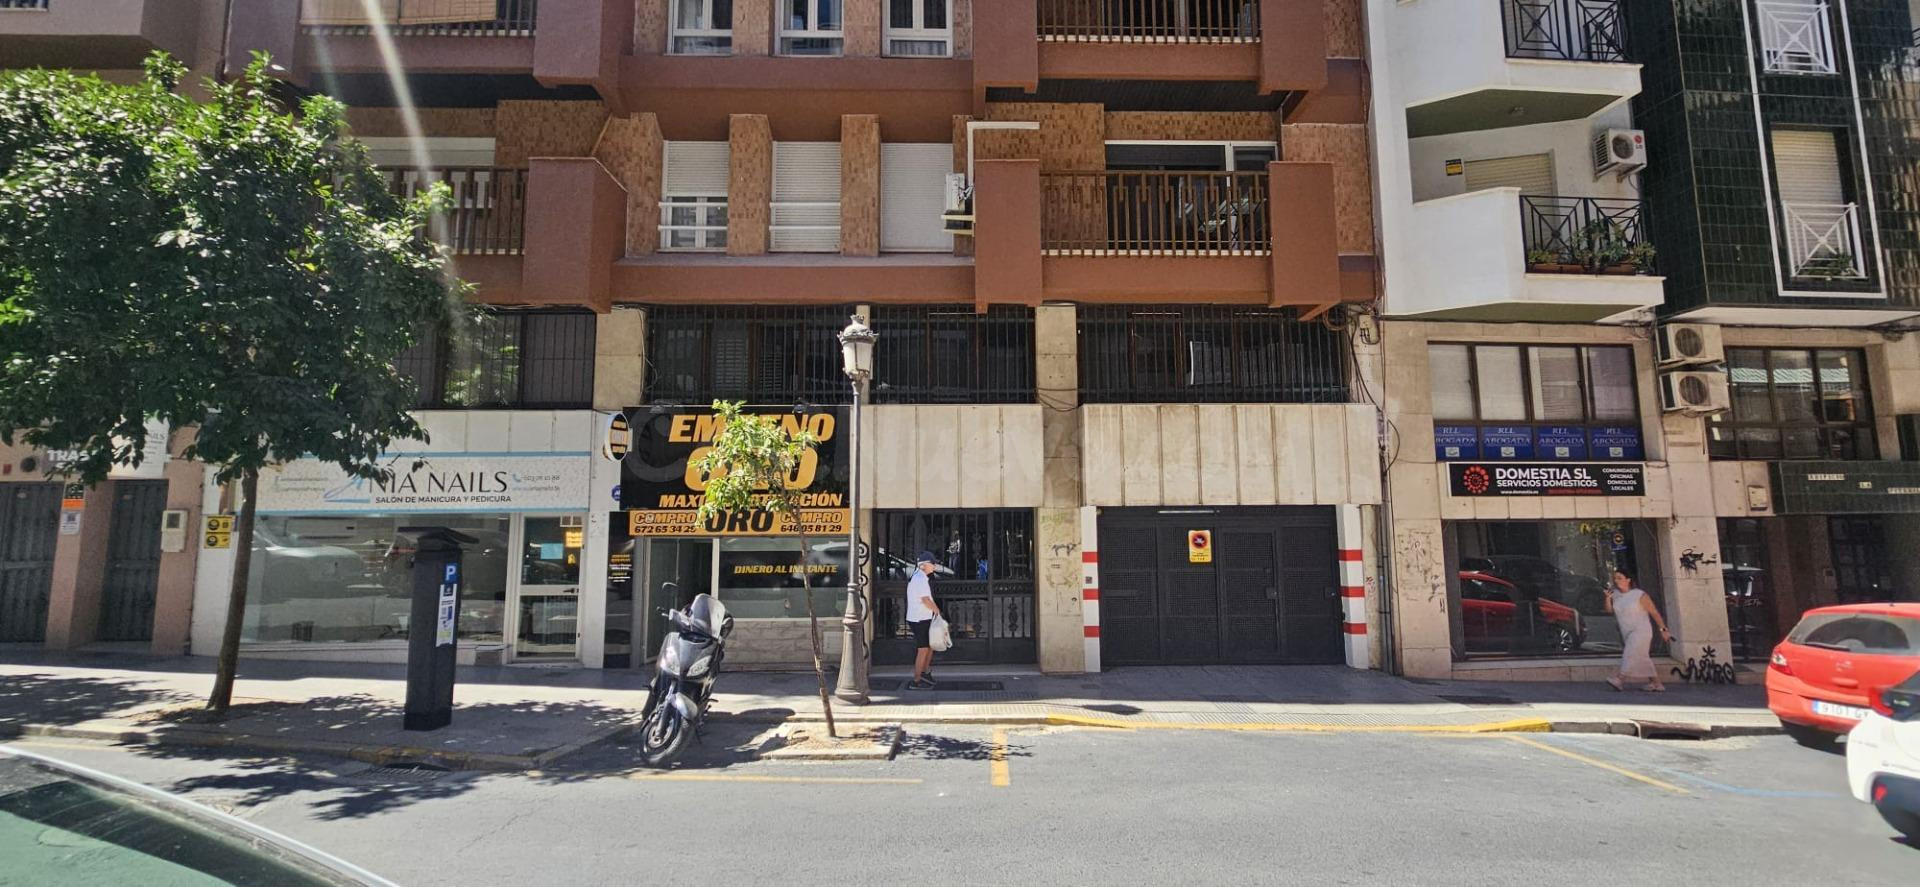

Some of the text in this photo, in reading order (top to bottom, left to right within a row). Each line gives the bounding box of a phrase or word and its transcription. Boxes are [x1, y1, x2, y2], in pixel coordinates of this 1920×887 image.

[1495, 468, 1592, 480] DOMESTIA SL
[428, 470, 508, 493] NAILS
[1496, 479, 1598, 488] SERVICIOS DOMESTICOS
[471, 495, 512, 503] PEDICURA
[635, 511, 697, 524] COMPRO
[705, 508, 774, 532] ORO
[635, 525, 654, 533] 672
[655, 525, 668, 533] 65
[669, 525, 681, 533] 34
[815, 524, 827, 533] 81
[829, 524, 842, 533] 29
[445, 563, 457, 581] P
[734, 564, 773, 574] DINERO
[773, 564, 787, 574] AL
